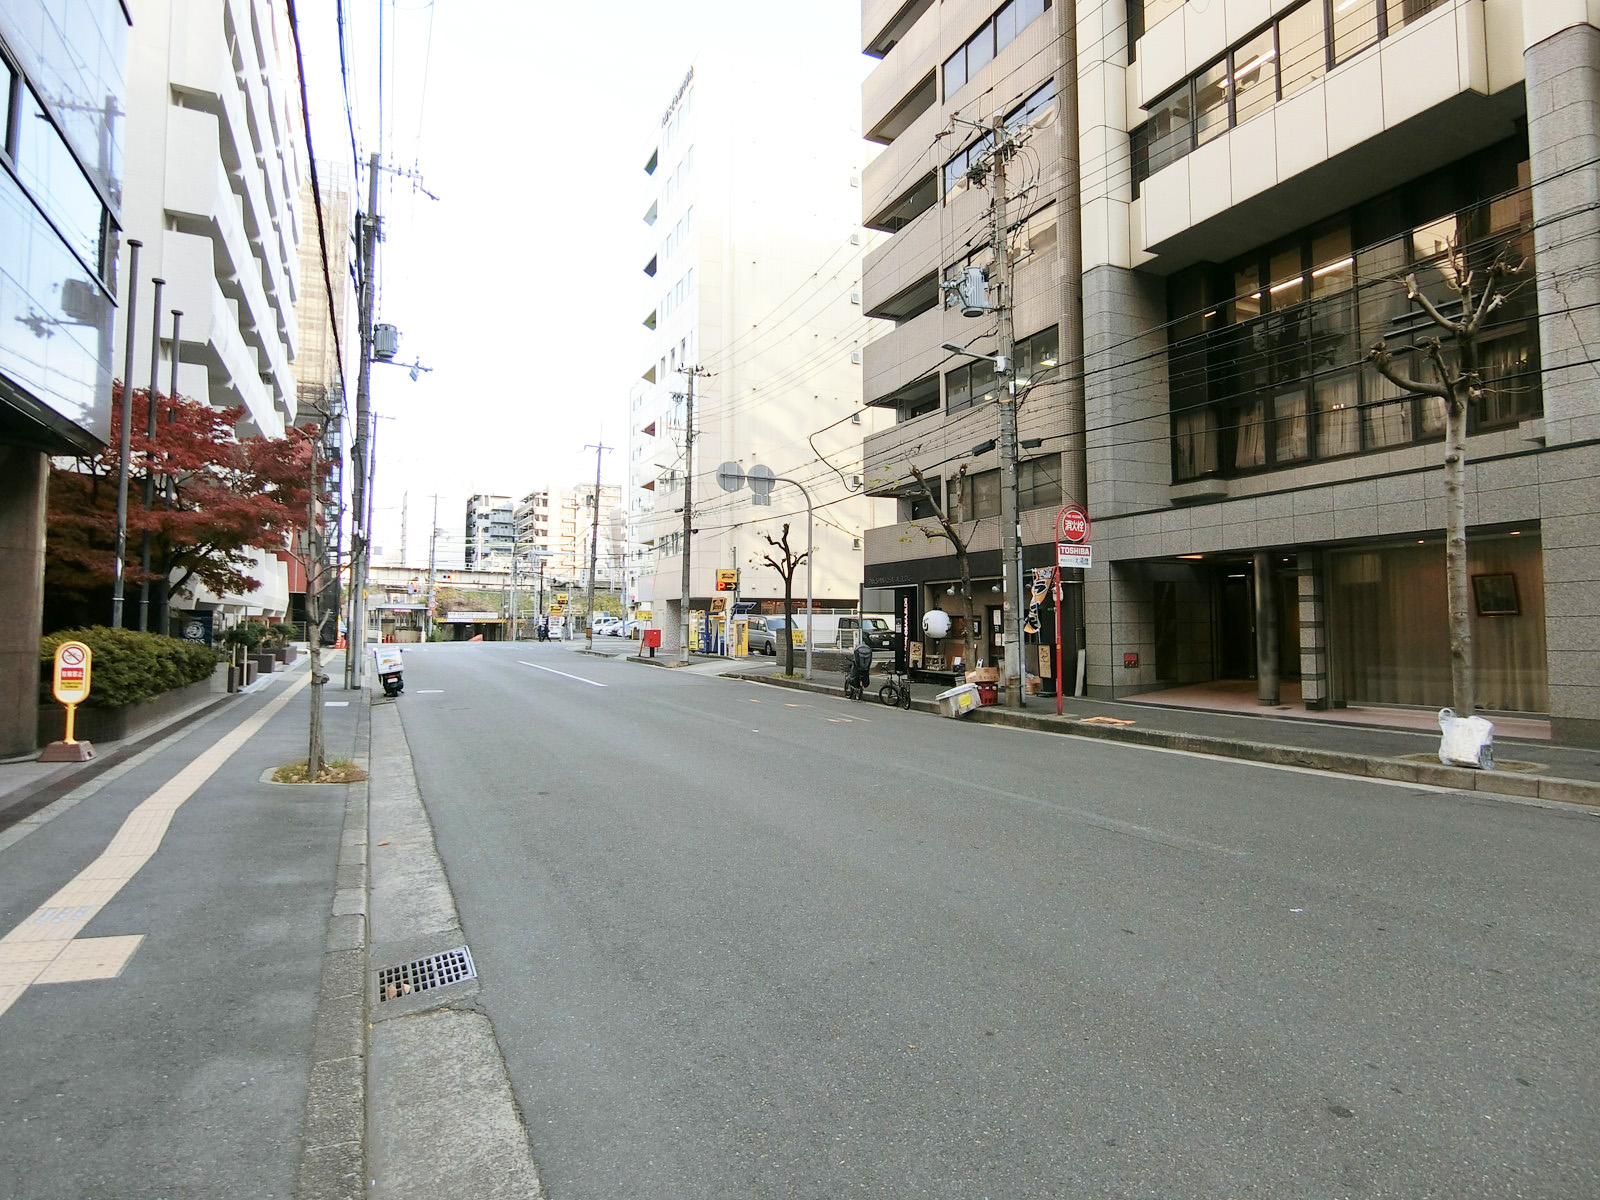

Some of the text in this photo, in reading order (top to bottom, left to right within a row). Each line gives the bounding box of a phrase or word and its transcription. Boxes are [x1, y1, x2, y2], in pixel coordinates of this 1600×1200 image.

[1065, 520, 1085, 533] 消火栓
[1060, 546, 1090, 556] TOSHIBA
[718, 582, 726, 591] P
